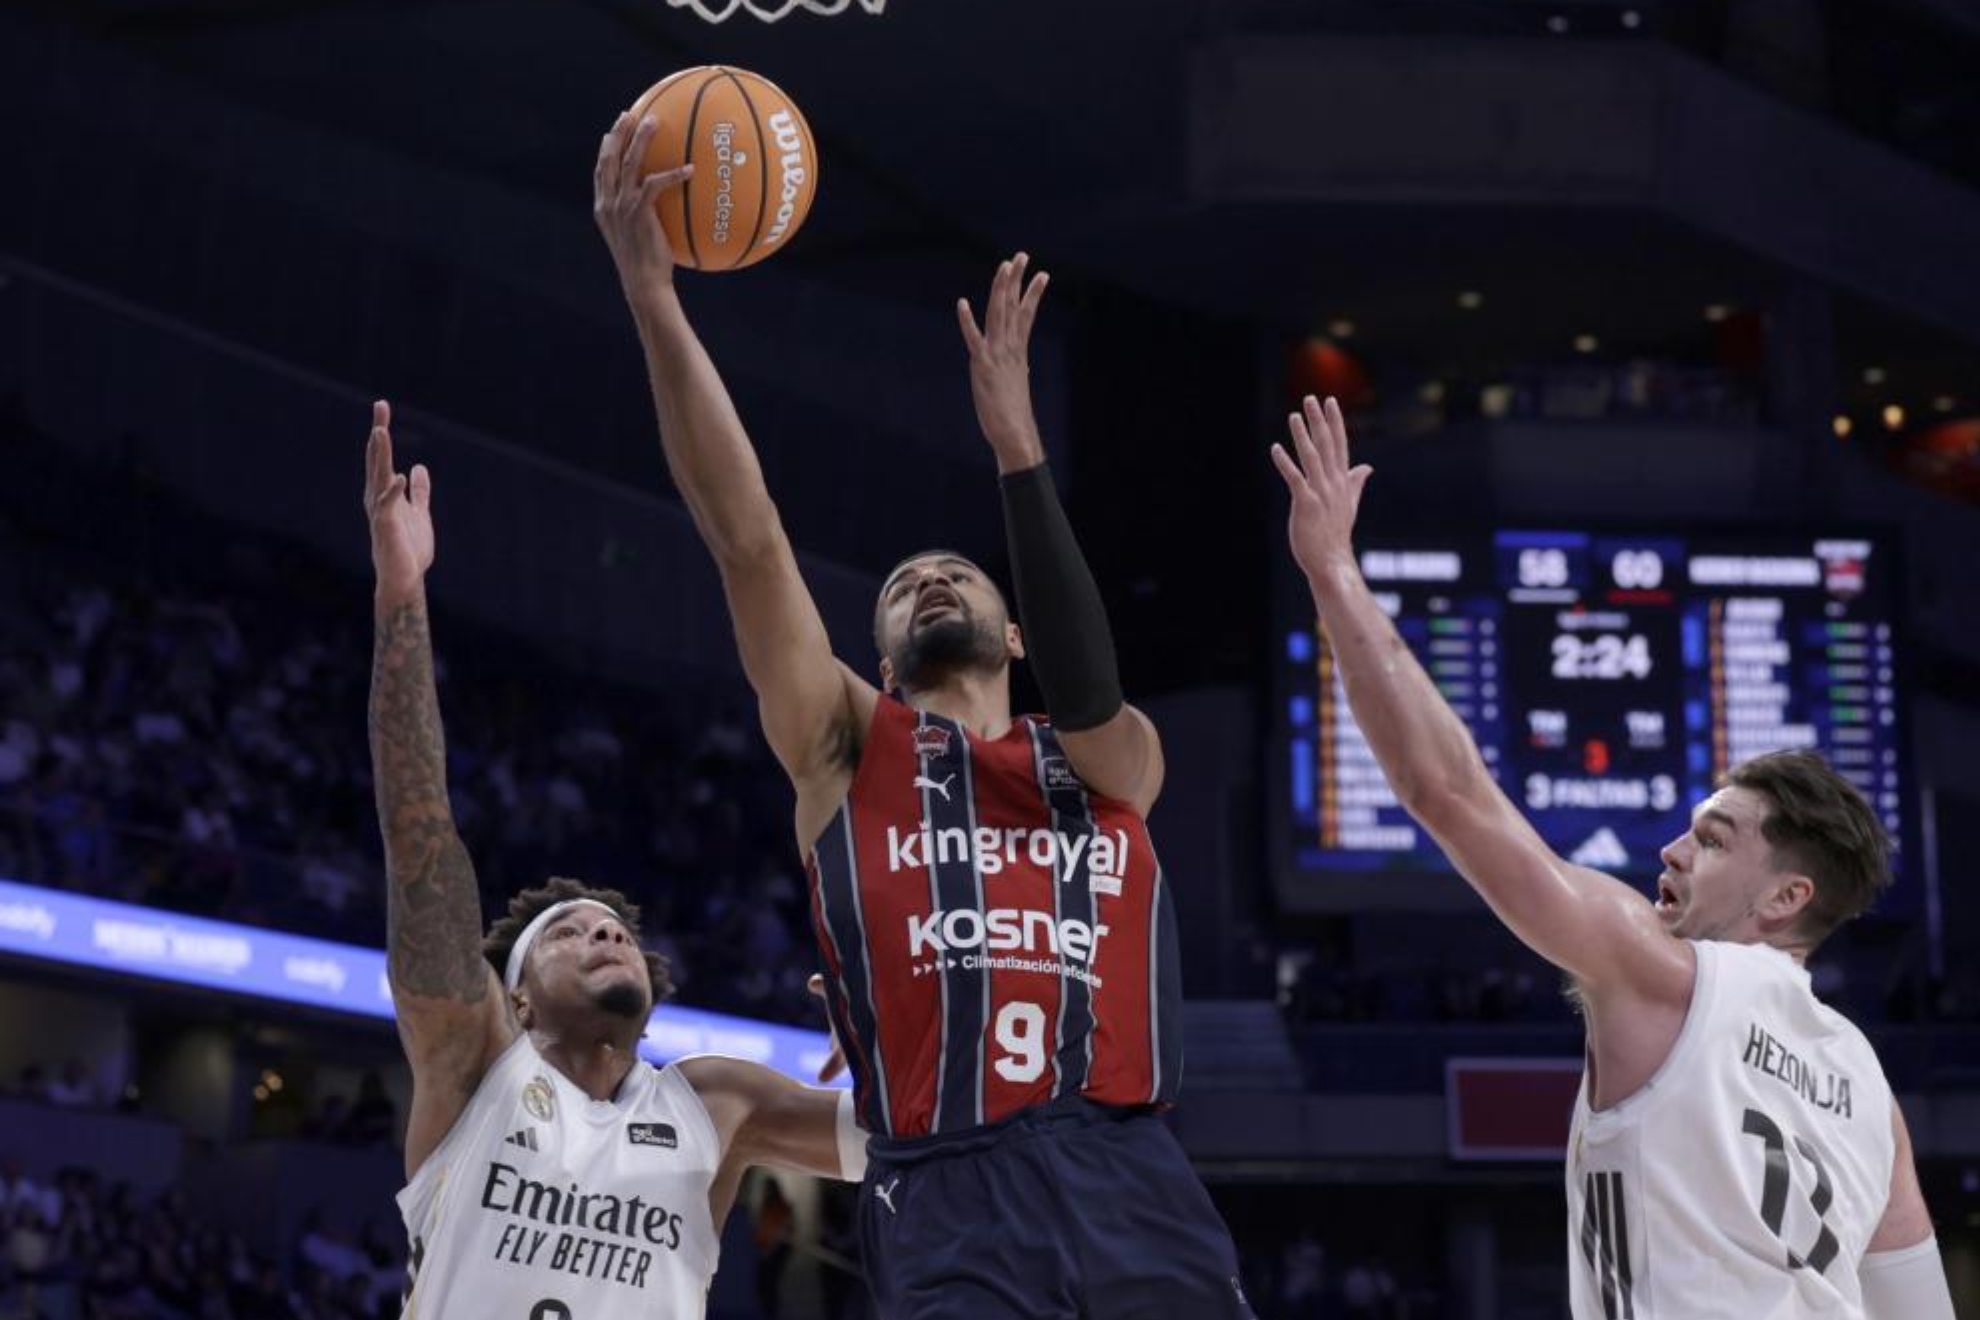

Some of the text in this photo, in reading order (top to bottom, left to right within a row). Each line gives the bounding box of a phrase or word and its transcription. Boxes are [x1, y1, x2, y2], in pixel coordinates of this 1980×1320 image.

[713, 122, 736, 243] liga endesa
[1551, 634, 1653, 680] 2:24
[887, 821, 1128, 882] kingroyal
[962, 954, 1062, 974] Climatización
[995, 1001, 1046, 1083] 9
[1743, 1022, 1852, 1119] HEZONJA
[481, 1161, 683, 1251] Emirates
[495, 1223, 653, 1289] FLY BETTER
